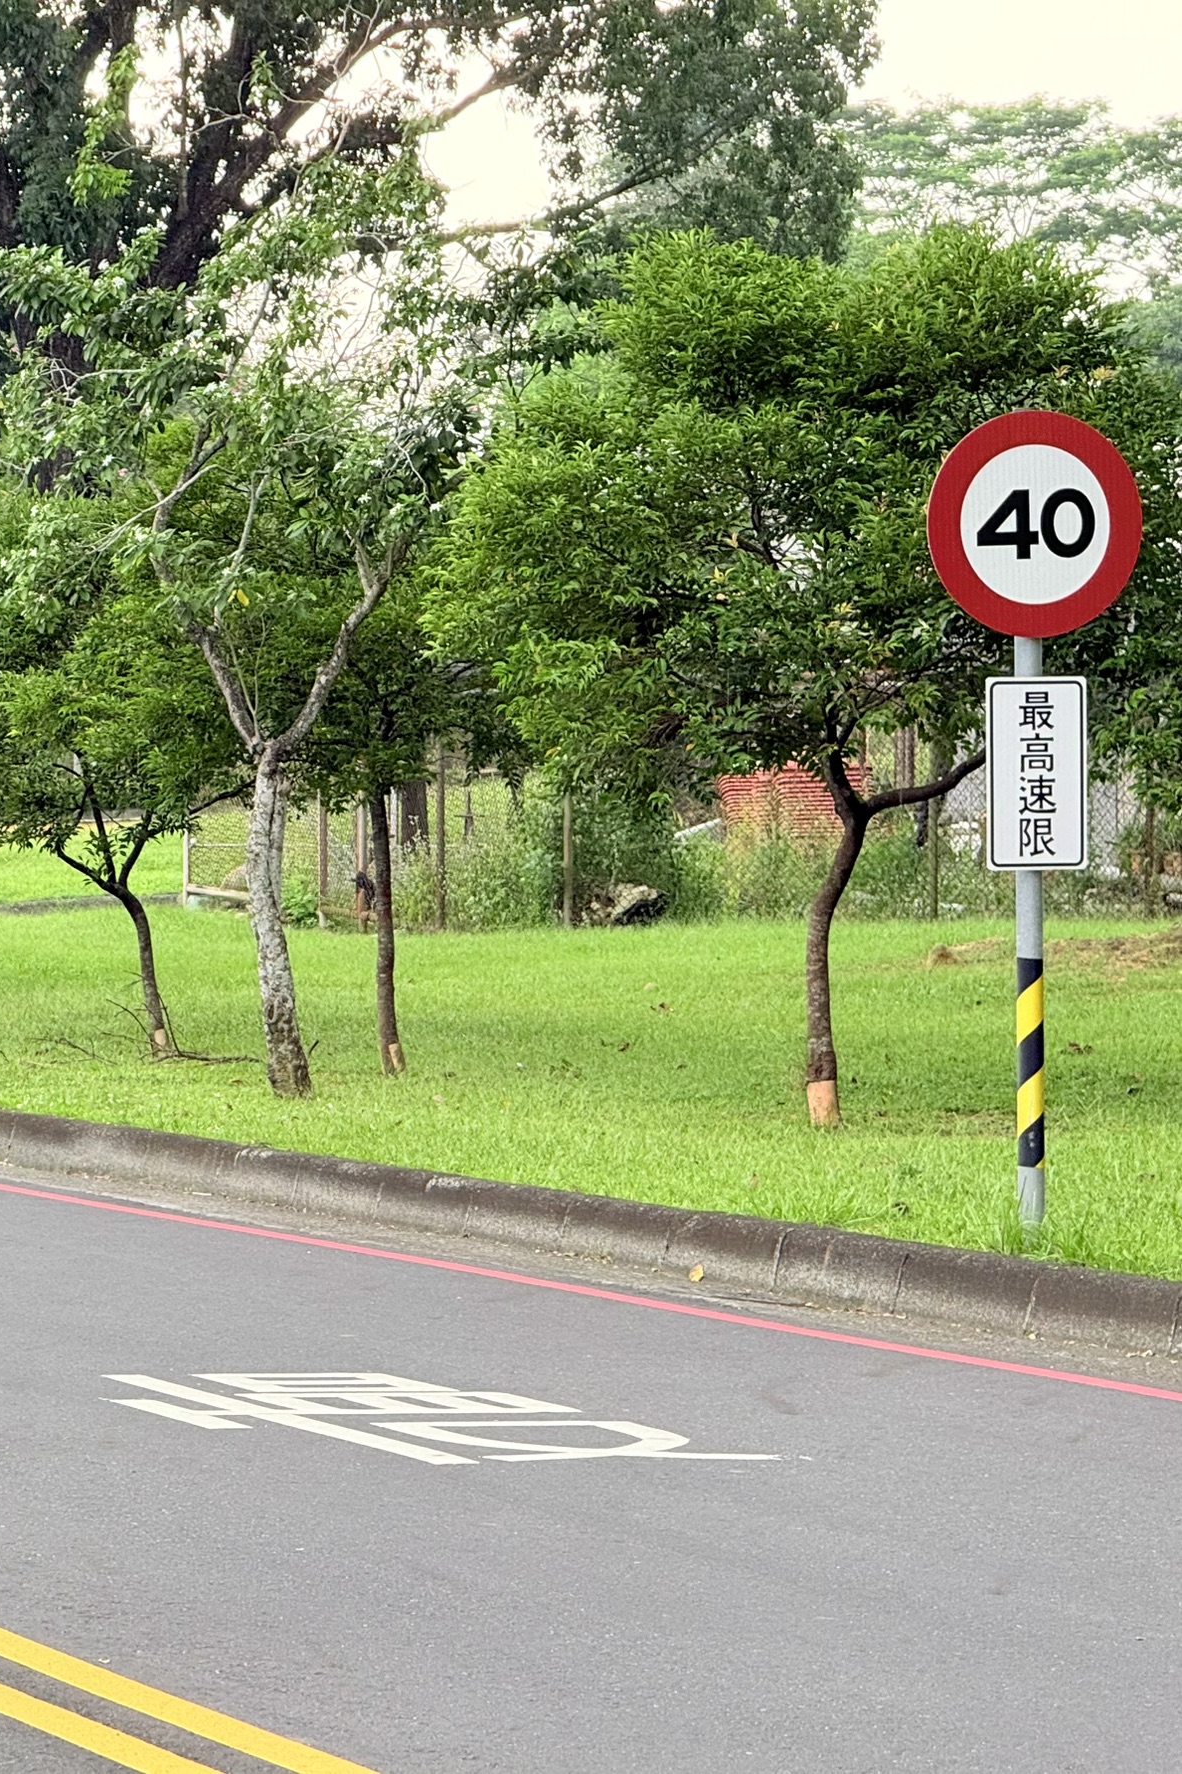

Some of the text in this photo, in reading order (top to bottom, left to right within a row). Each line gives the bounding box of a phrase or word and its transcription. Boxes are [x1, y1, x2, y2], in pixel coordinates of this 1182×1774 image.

[976, 487, 1096, 560] 40
[1018, 690, 1057, 857] 最高速限
[99, 1372, 813, 1465] 慢
